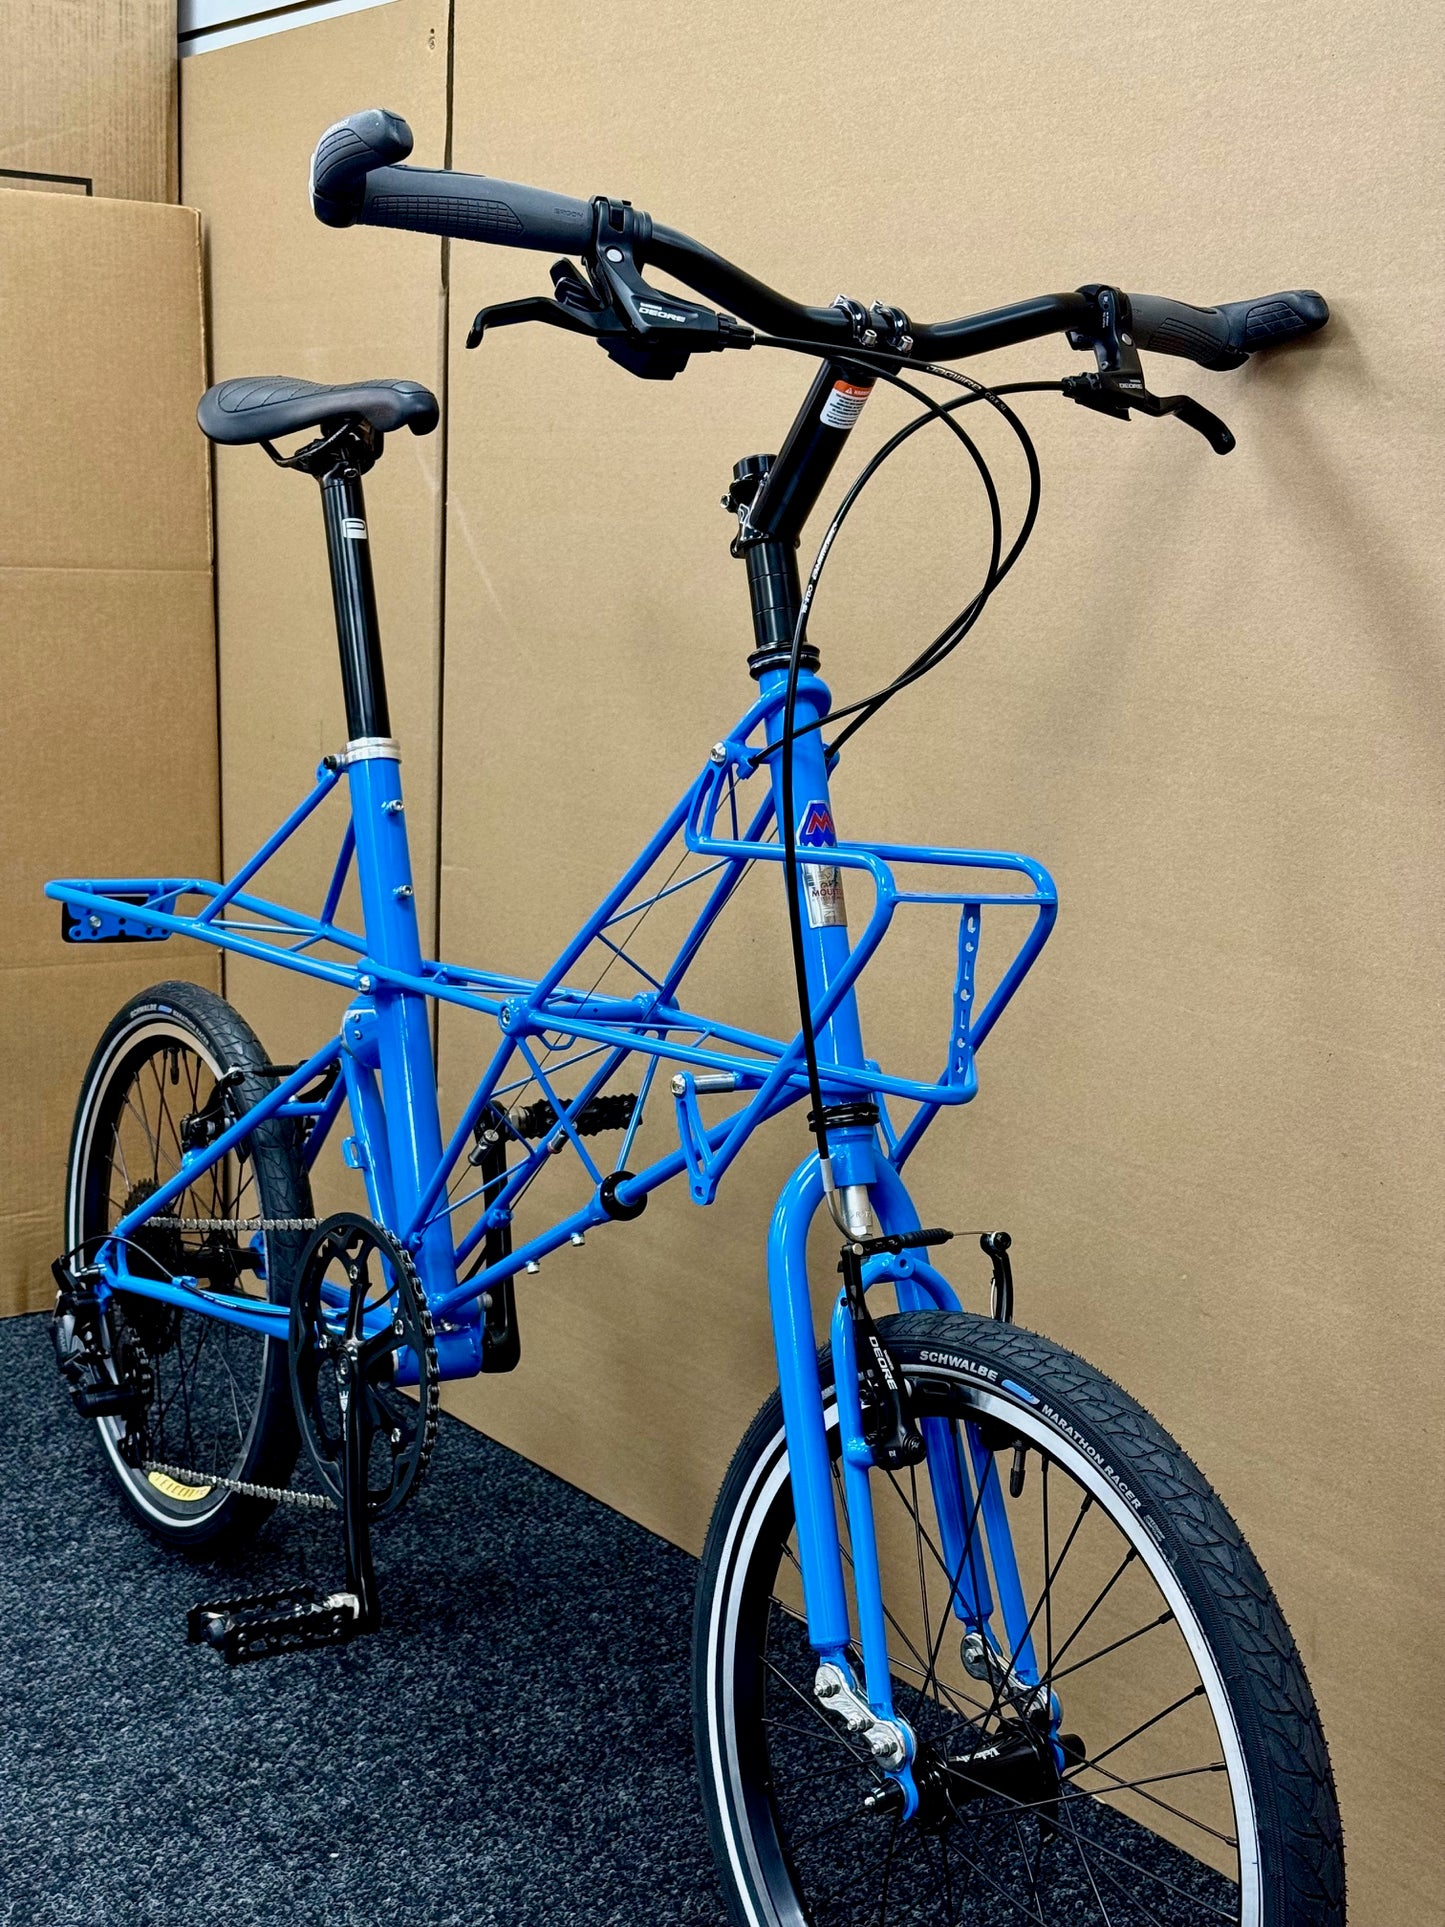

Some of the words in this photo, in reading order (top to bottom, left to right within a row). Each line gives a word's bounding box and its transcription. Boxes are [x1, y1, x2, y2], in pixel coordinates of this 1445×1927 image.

[638, 306, 686, 323] DEORE
[868, 1335, 899, 1391] DEORE
[919, 1350, 999, 1382] SCHWALBE
[1041, 1403, 1105, 1466] MARATHON
[1103, 1464, 1143, 1510] RACER
